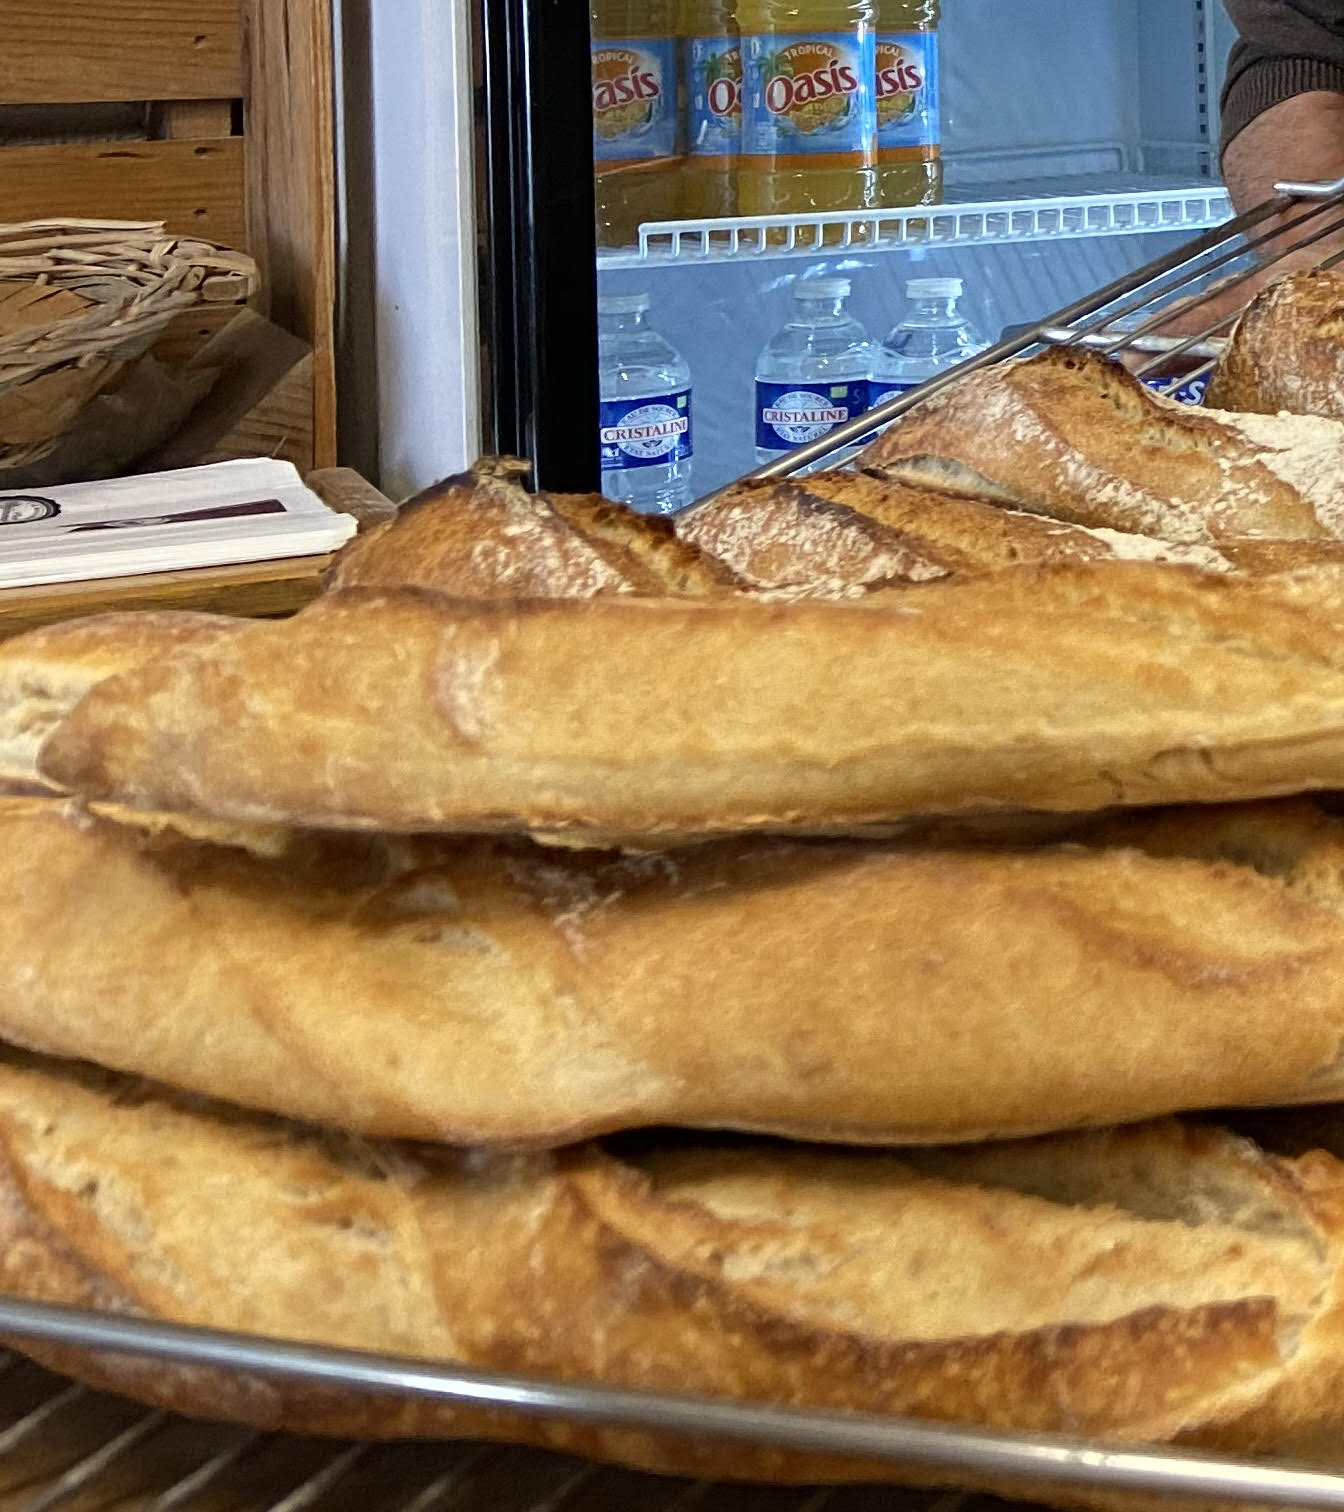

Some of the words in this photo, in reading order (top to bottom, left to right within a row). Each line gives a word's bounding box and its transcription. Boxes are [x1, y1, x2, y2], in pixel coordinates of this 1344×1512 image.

[784, 44, 835, 59] TROPICAL
[594, 66, 660, 111] asis
[766, 58, 858, 114] Oasis
[764, 410, 848, 422] CRISTALINE
